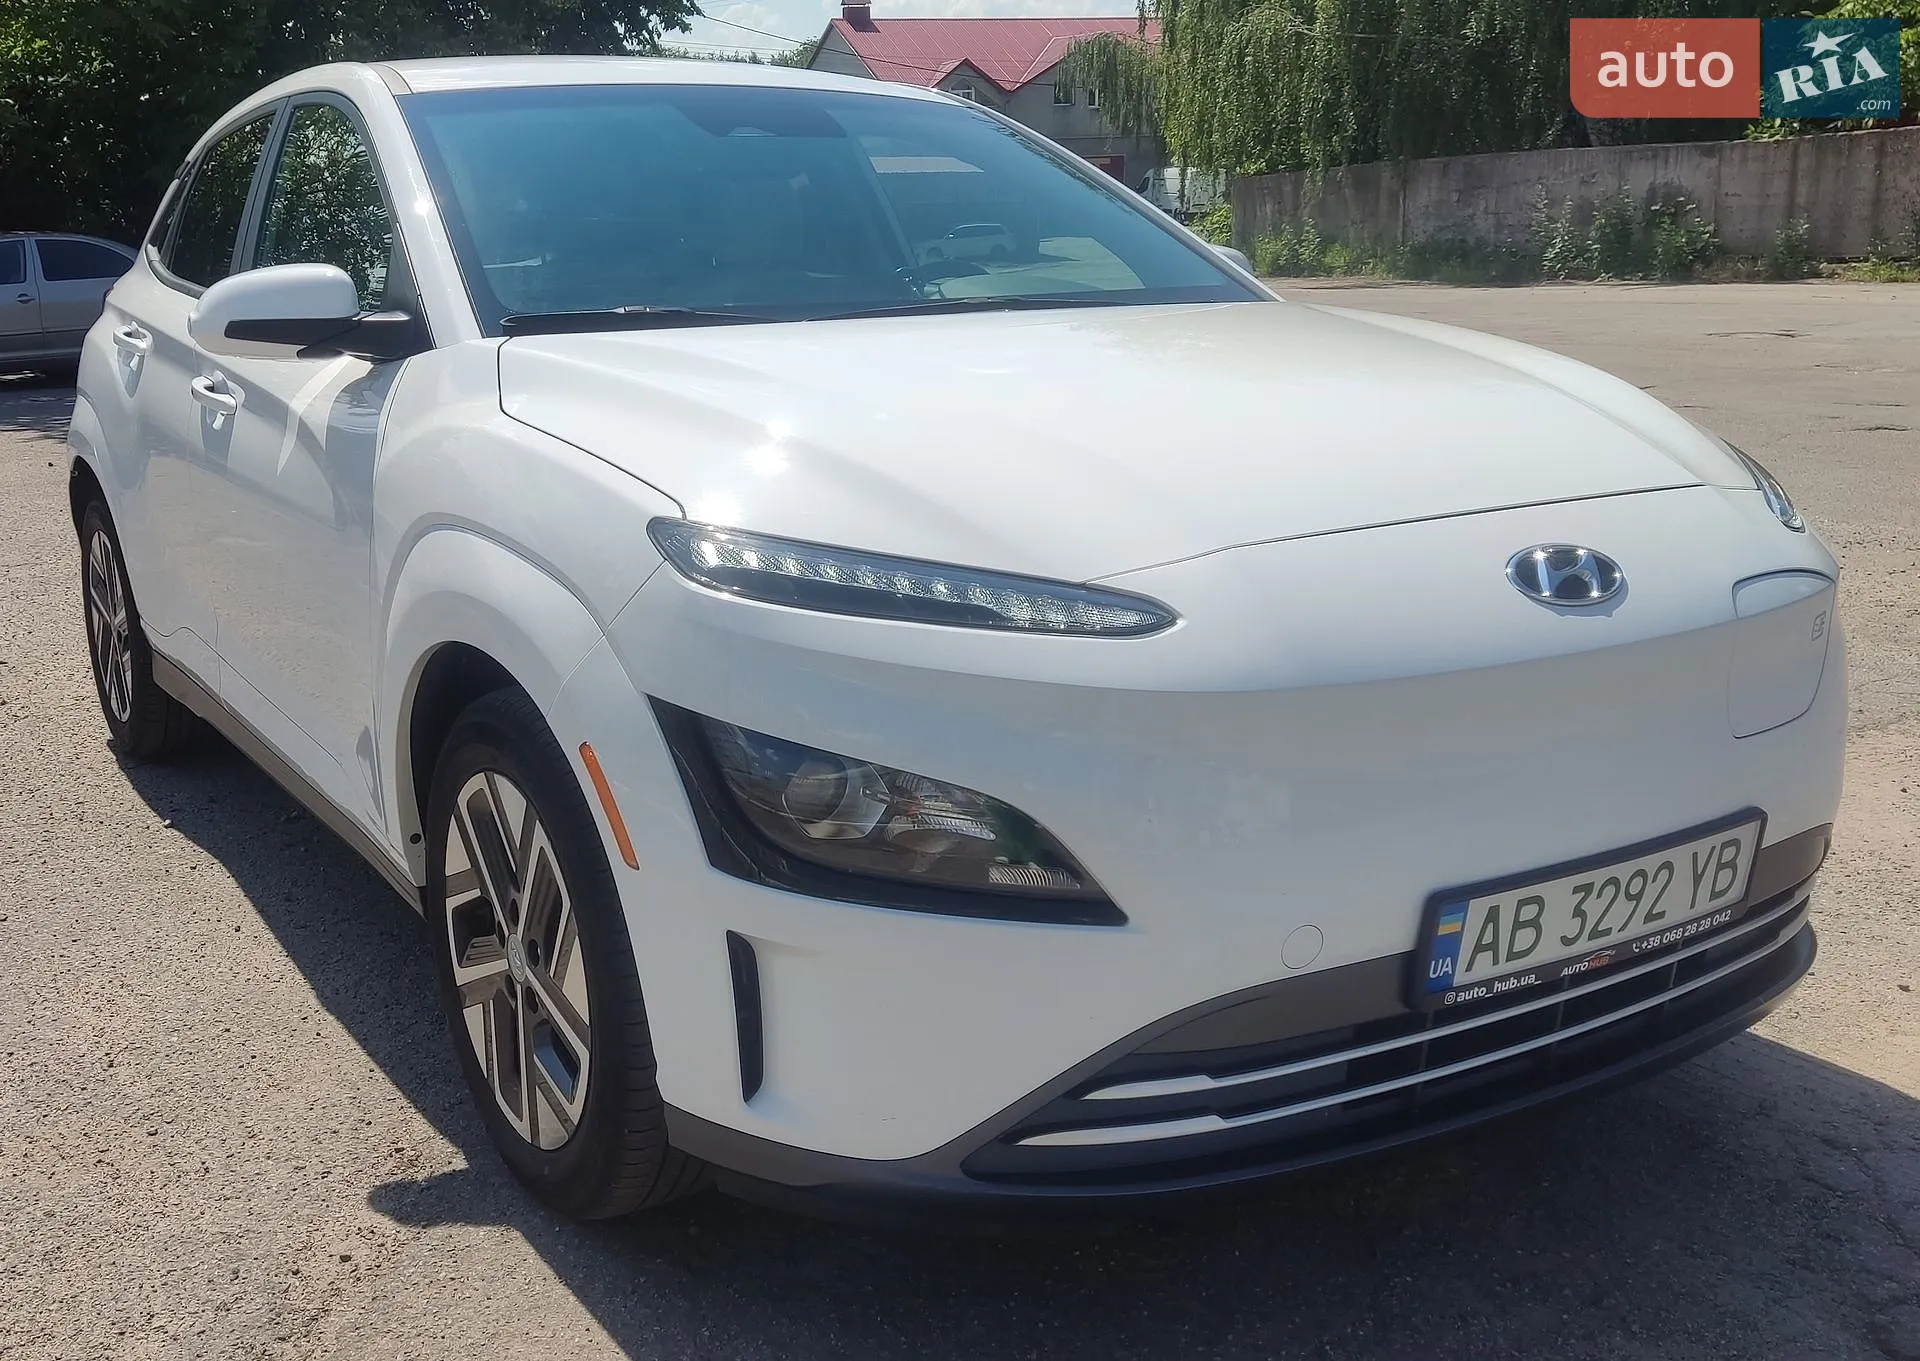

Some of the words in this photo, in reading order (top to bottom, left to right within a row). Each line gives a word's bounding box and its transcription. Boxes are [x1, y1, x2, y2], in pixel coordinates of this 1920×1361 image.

[1465, 895, 1545, 972] AB
[1560, 860, 1675, 947] 3292
[1690, 837, 1742, 910] YB
[1641, 935, 1661, 949] +38
[1662, 928, 1684, 944] 068
[1683, 923, 1698, 937] 28
[1698, 918, 1712, 931] 28
[1713, 910, 1732, 926] 042
[1429, 956, 1453, 979] UA
